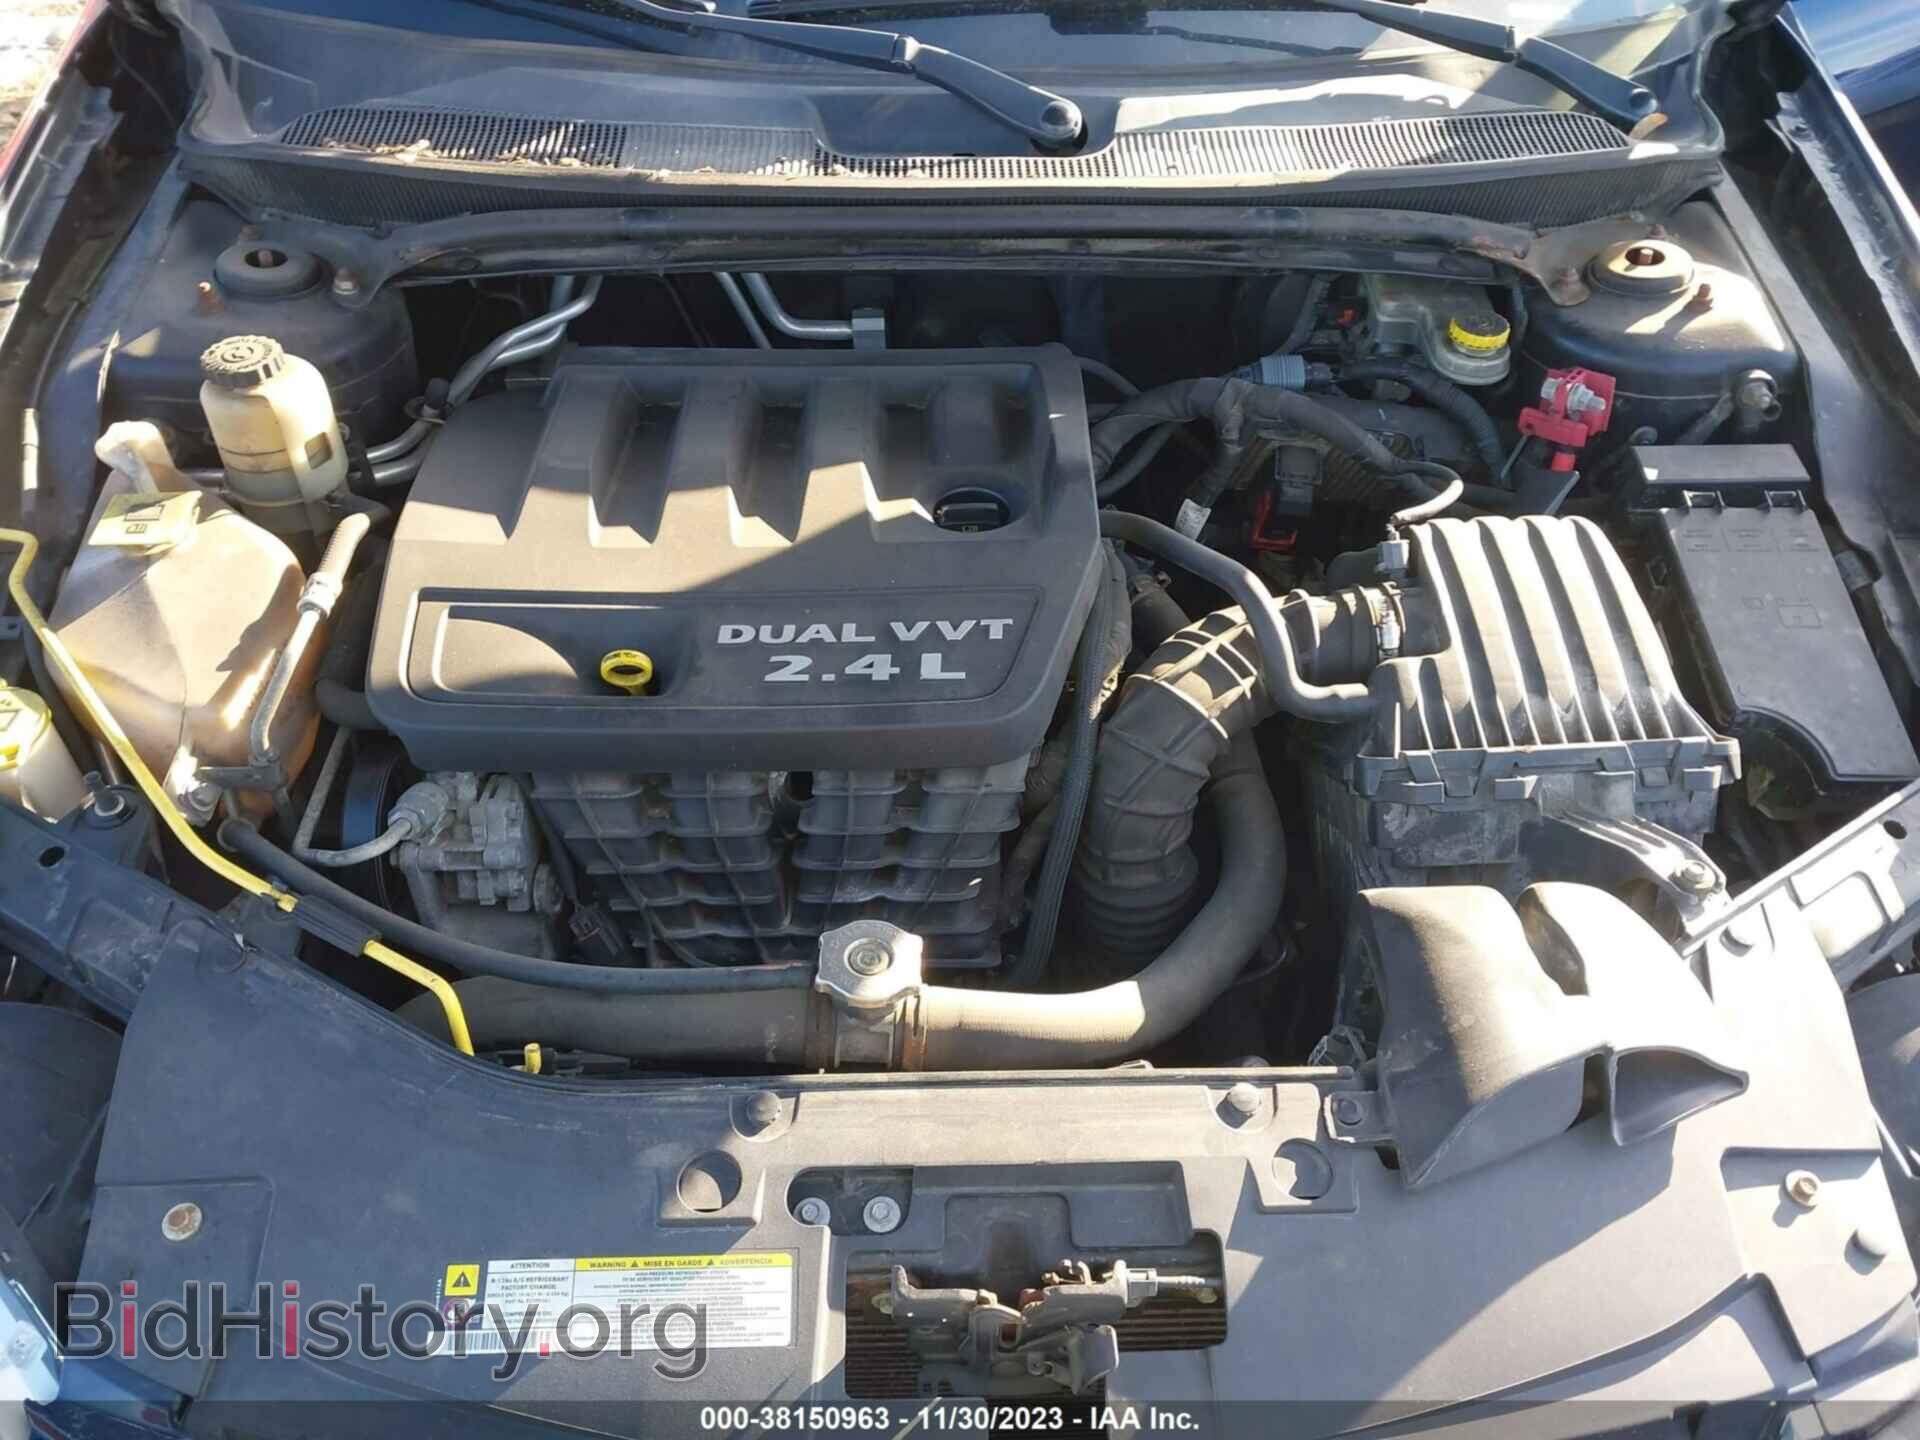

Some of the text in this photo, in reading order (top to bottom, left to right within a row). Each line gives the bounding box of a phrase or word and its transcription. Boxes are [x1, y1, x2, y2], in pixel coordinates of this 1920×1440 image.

[717, 618, 1013, 644] DUAL VVT
[764, 652, 966, 682] 2.4 L
[720, 1257, 773, 1265] ADVERTENCIA
